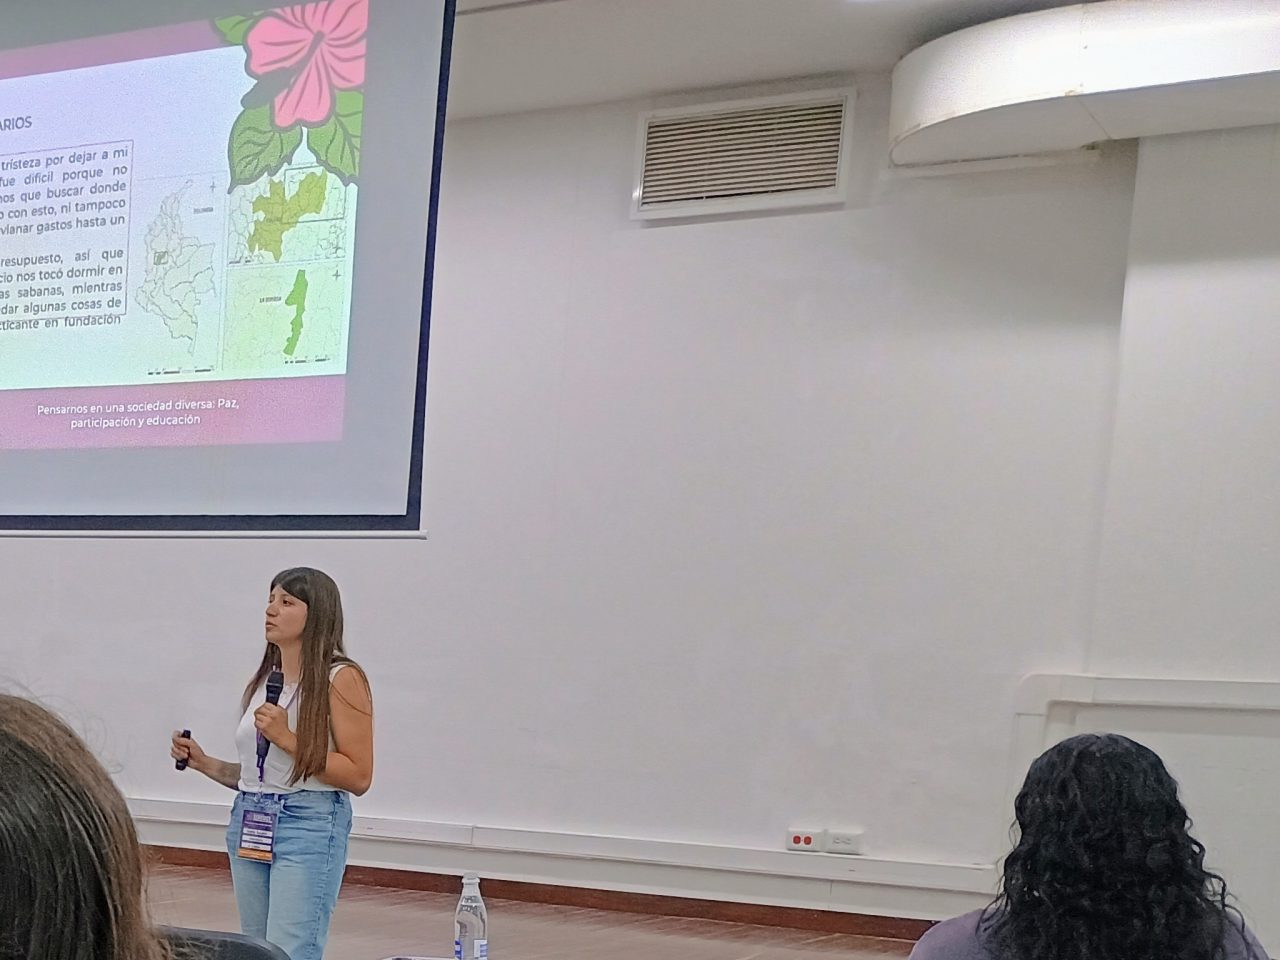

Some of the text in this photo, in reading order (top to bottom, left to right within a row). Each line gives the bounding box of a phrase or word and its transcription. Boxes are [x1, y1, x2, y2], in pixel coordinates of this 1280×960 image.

[2, 158, 41, 171] tristeza
[46, 155, 64, 168] por
[68, 151, 97, 165] dejar
[102, 150, 108, 160] a
[113, 145, 128, 158] mi
[0, 176, 15, 188] fue
[63, 168, 104, 183] porque
[113, 165, 128, 176] no
[20, 191, 41, 204] que
[47, 186, 84, 199] buscar
[89, 180, 127, 195] donde
[8, 208, 27, 219] con
[31, 205, 57, 217] esto,
[61, 202, 71, 214] ni
[74, 199, 126, 213] tampoco
[36, 220, 73, 234] gastos
[75, 217, 107, 229] hasta
[110, 216, 125, 226] un
[101, 249, 124, 262] que
[16, 272, 36, 282] nos
[39, 269, 64, 281] tocó
[66, 265, 105, 278] dormir
[108, 266, 123, 276] en
[17, 286, 65, 299] sabanas,
[72, 281, 123, 295] mientras
[23, 301, 66, 316] algunas
[71, 299, 102, 311] cosas
[107, 296, 121, 308] de
[45, 319, 59, 328] en
[90, 404, 103, 414] en
[105, 404, 125, 413] una
[127, 400, 173, 413] sociedad
[174, 399, 216, 410] diversa:
[218, 398, 240, 410] Paz,
[71, 413, 201, 430] participación y educación
